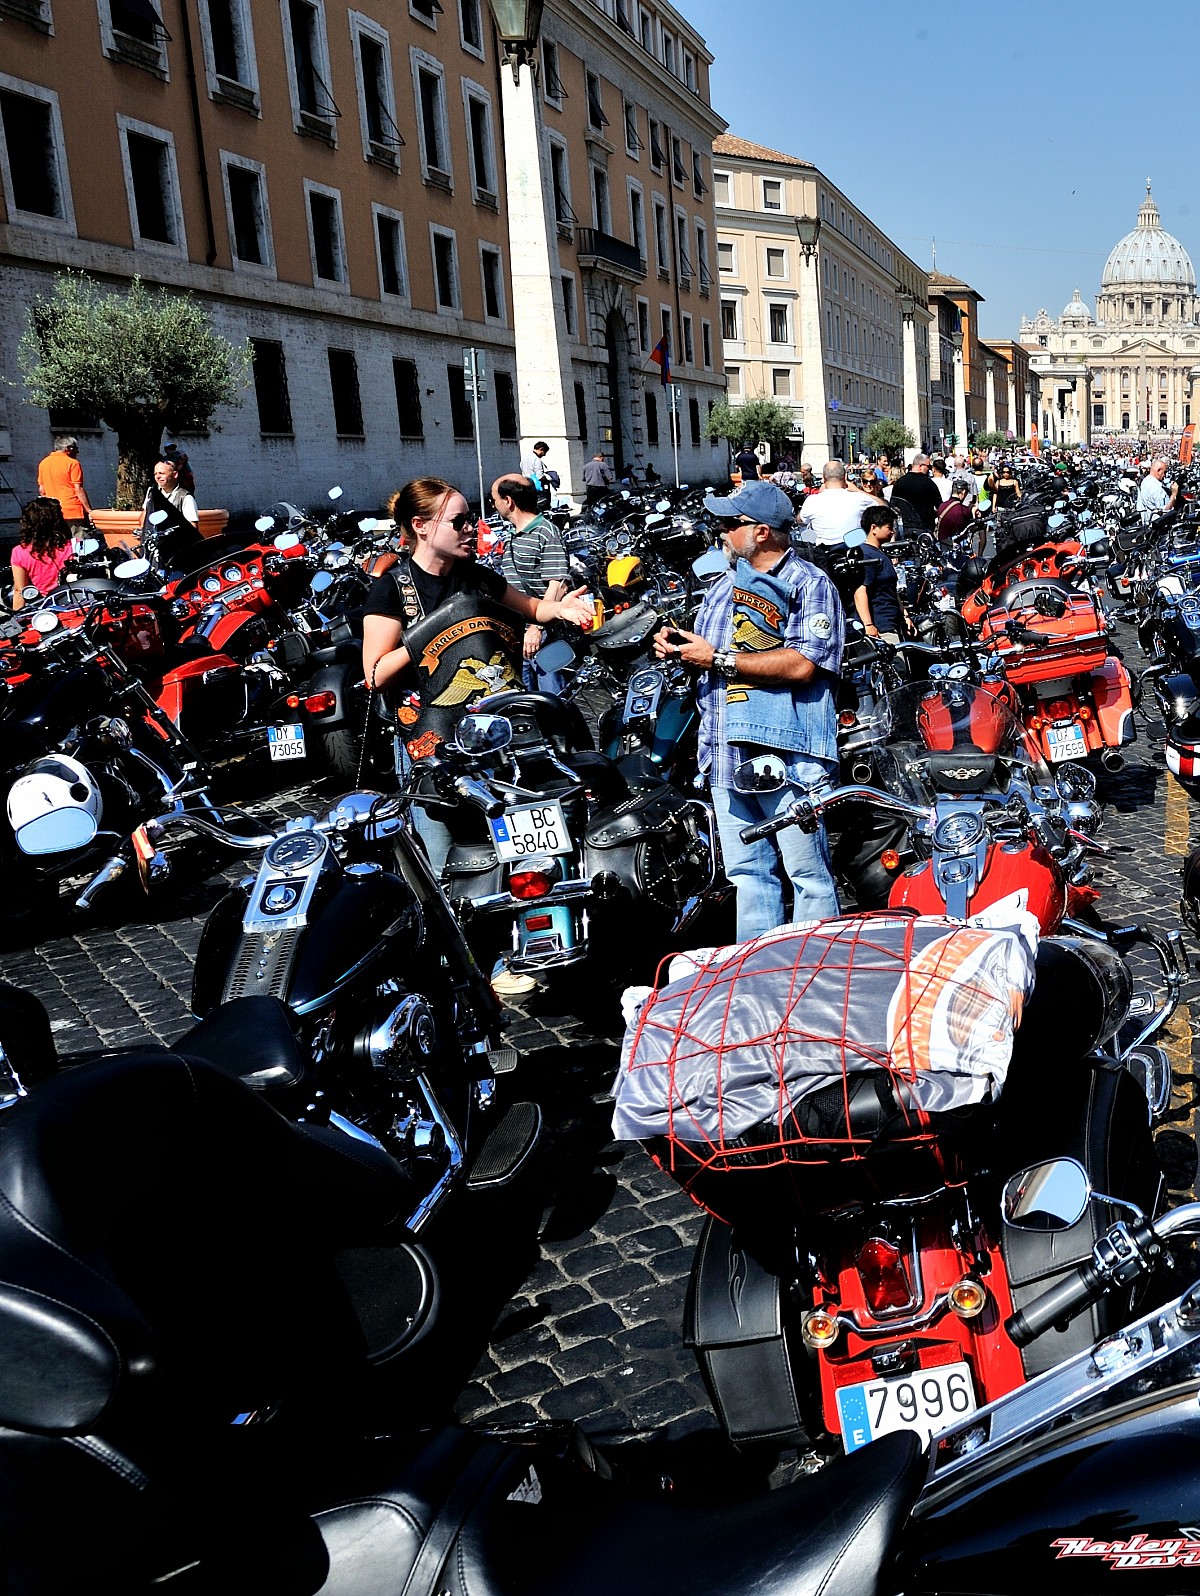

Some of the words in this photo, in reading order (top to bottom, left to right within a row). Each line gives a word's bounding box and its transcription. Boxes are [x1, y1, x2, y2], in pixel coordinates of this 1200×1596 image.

[428, 626, 464, 655] HARLEY
[271, 741, 303, 757] 73055
[1052, 741, 1085, 758] 77599
[505, 813, 517, 833] T
[530, 807, 556, 829] BC
[497, 829, 506, 837] E
[511, 830, 559, 855] 5840
[868, 1373, 970, 1429] 7996
[852, 1428, 866, 1445] E
